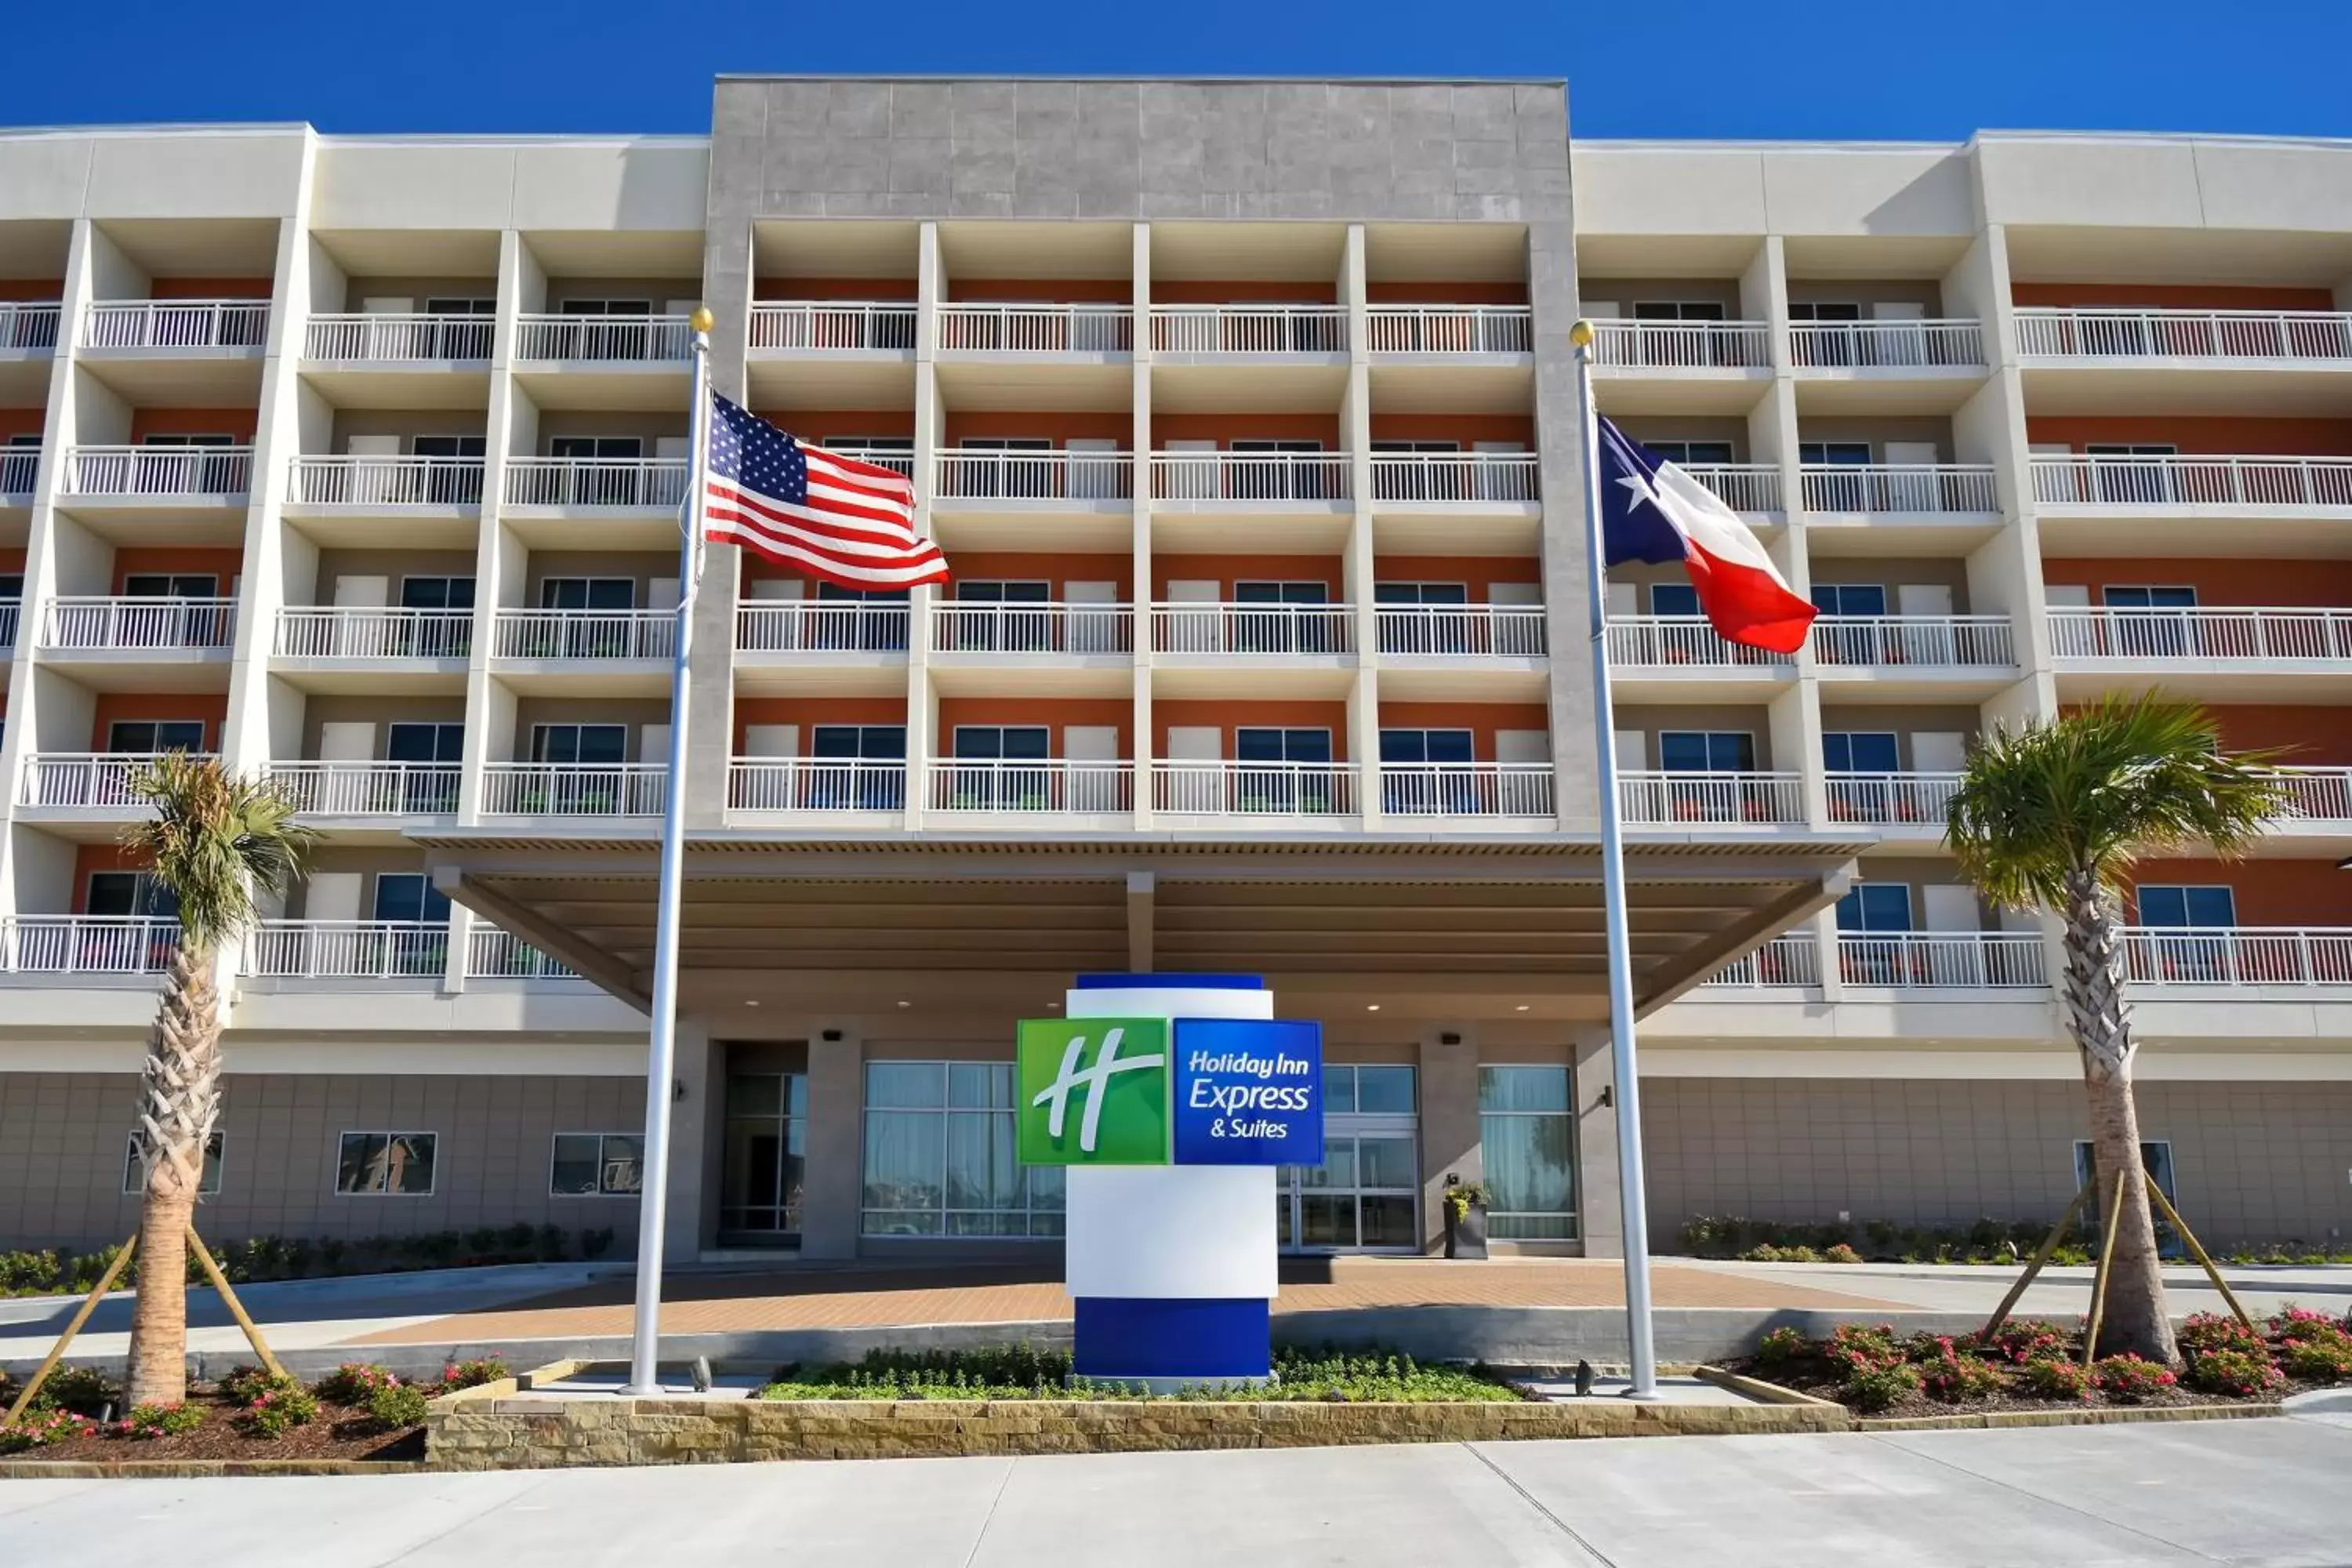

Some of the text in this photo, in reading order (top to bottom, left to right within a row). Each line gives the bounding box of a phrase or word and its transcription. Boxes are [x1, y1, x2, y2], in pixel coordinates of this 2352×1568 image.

[1189, 1050, 1308, 1080] Holiday Inn
[1189, 1078, 1309, 1116] Express
[1211, 1118, 1287, 1138] & Suites
